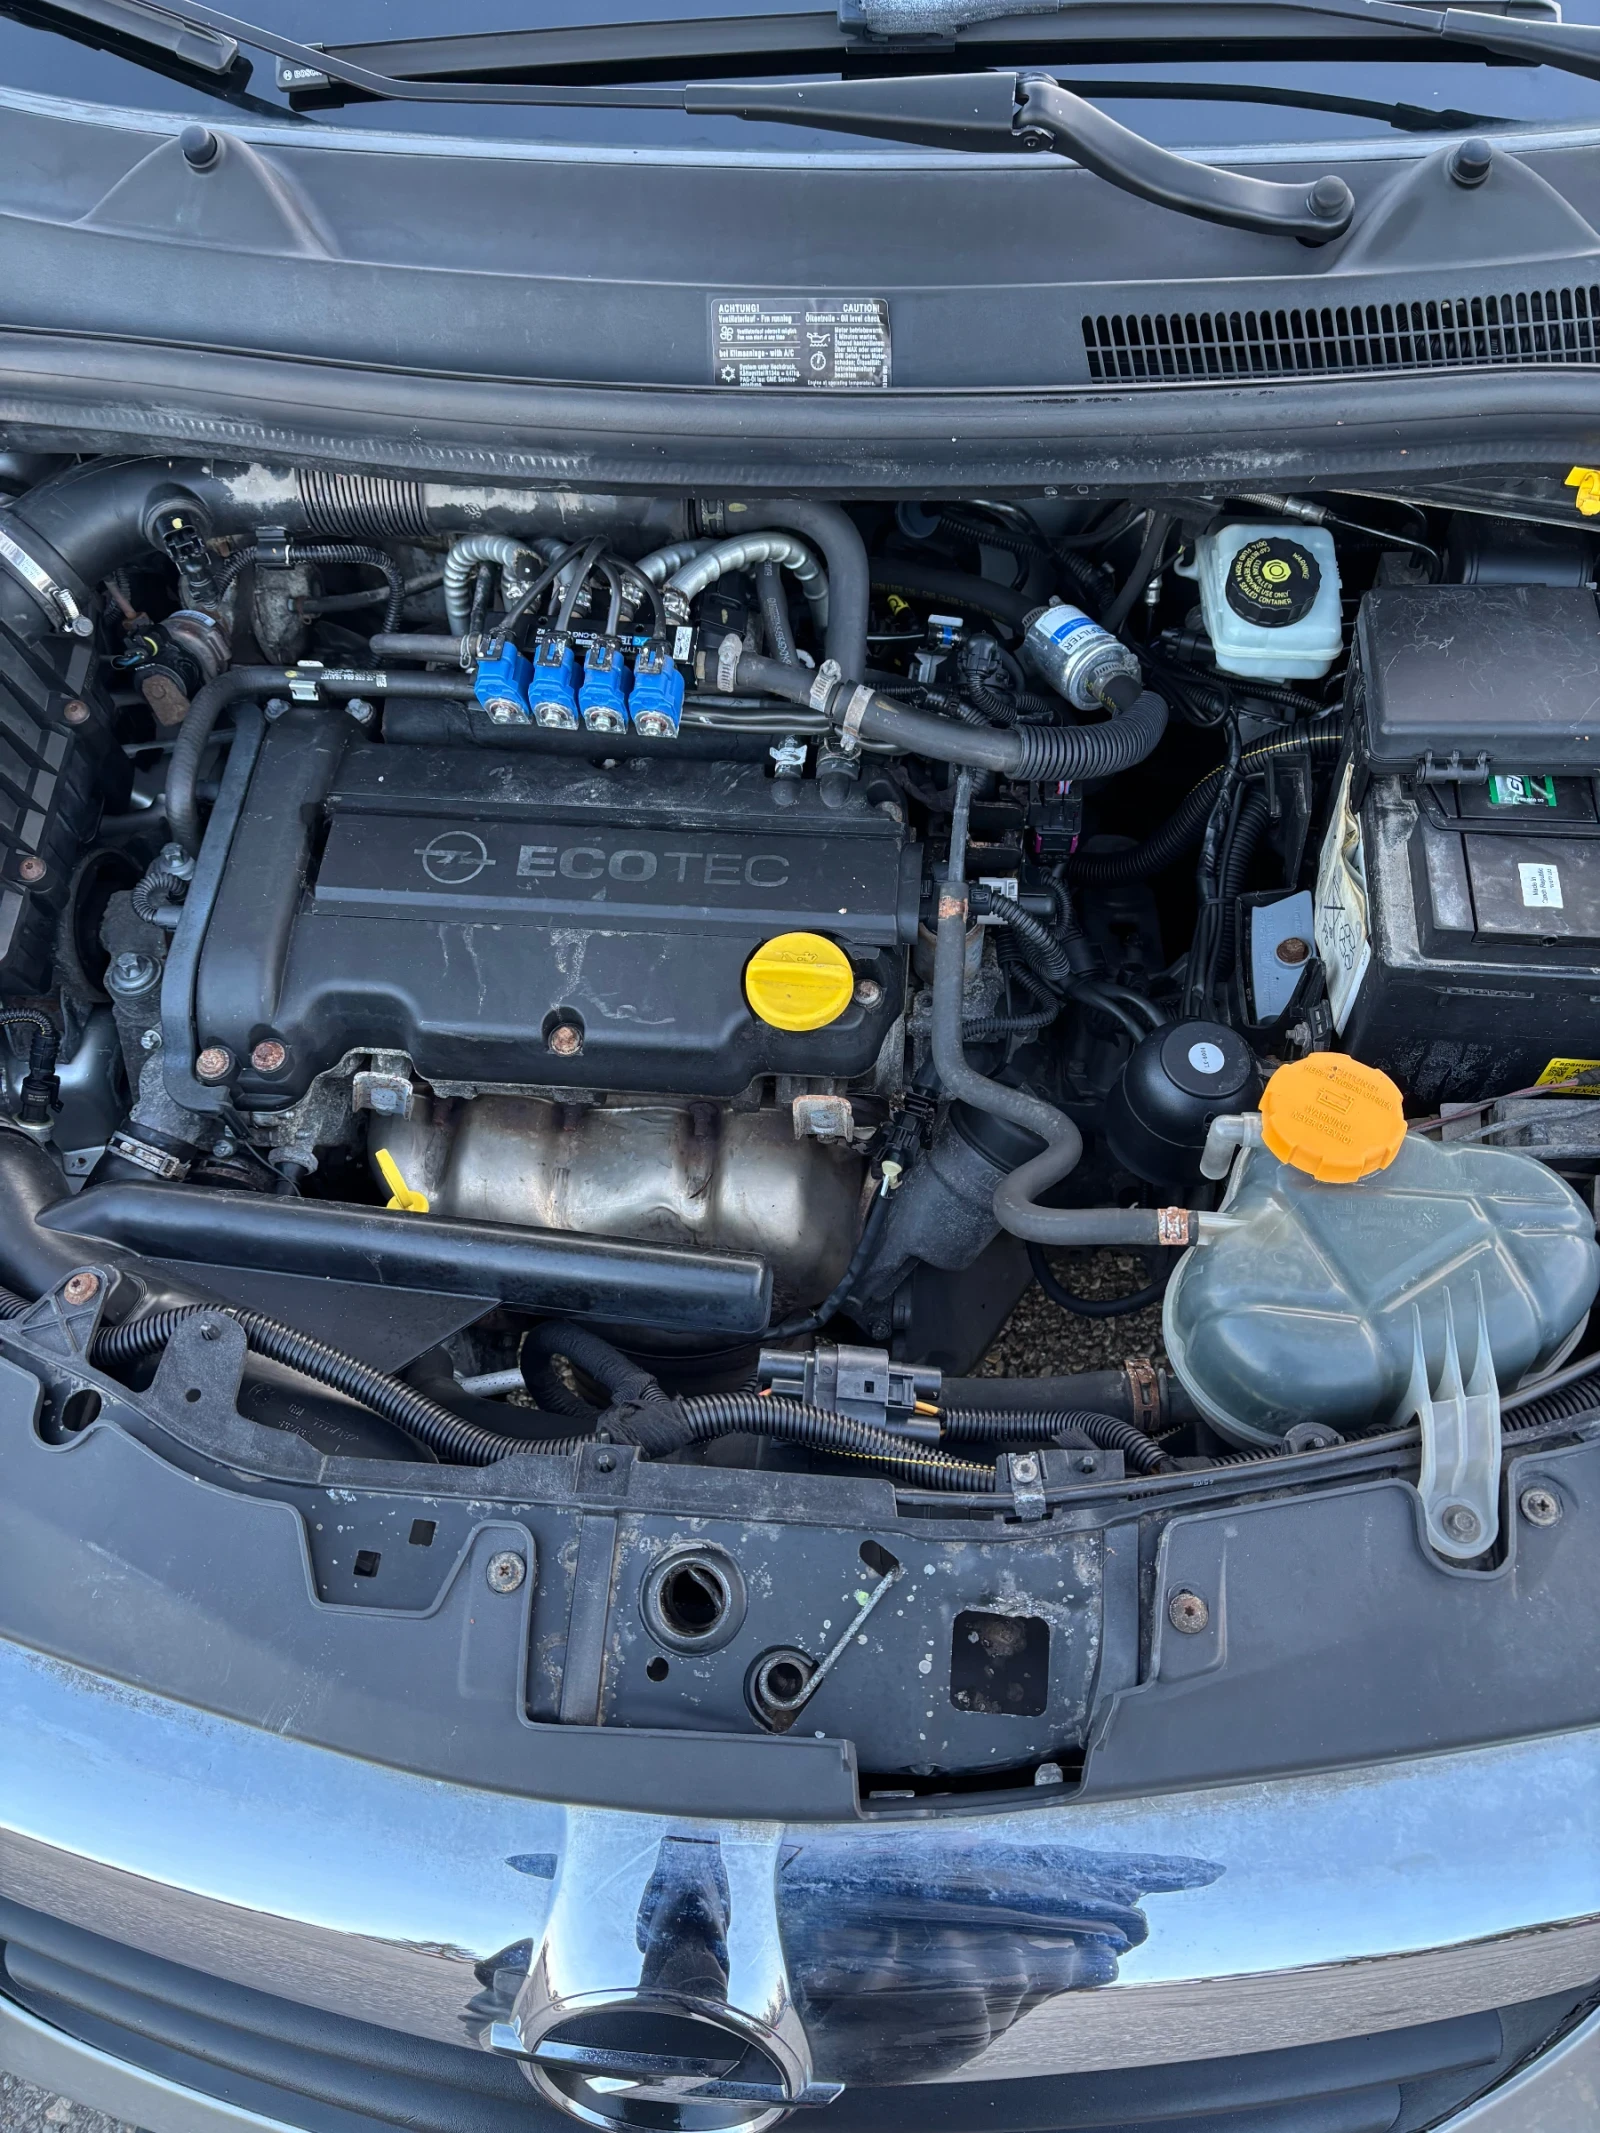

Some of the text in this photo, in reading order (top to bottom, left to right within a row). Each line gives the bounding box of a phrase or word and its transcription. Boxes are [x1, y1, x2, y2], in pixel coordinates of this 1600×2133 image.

[718, 304, 760, 312] ACHTUNG!
[843, 304, 880, 312] CAUTION!
[784, 349, 794, 358] A/C
[515, 844, 790, 888] ECOTEC
[1305, 1104, 1352, 1132] WARNING!
[1292, 1110, 1354, 1145] NEVER OPEN HOT
